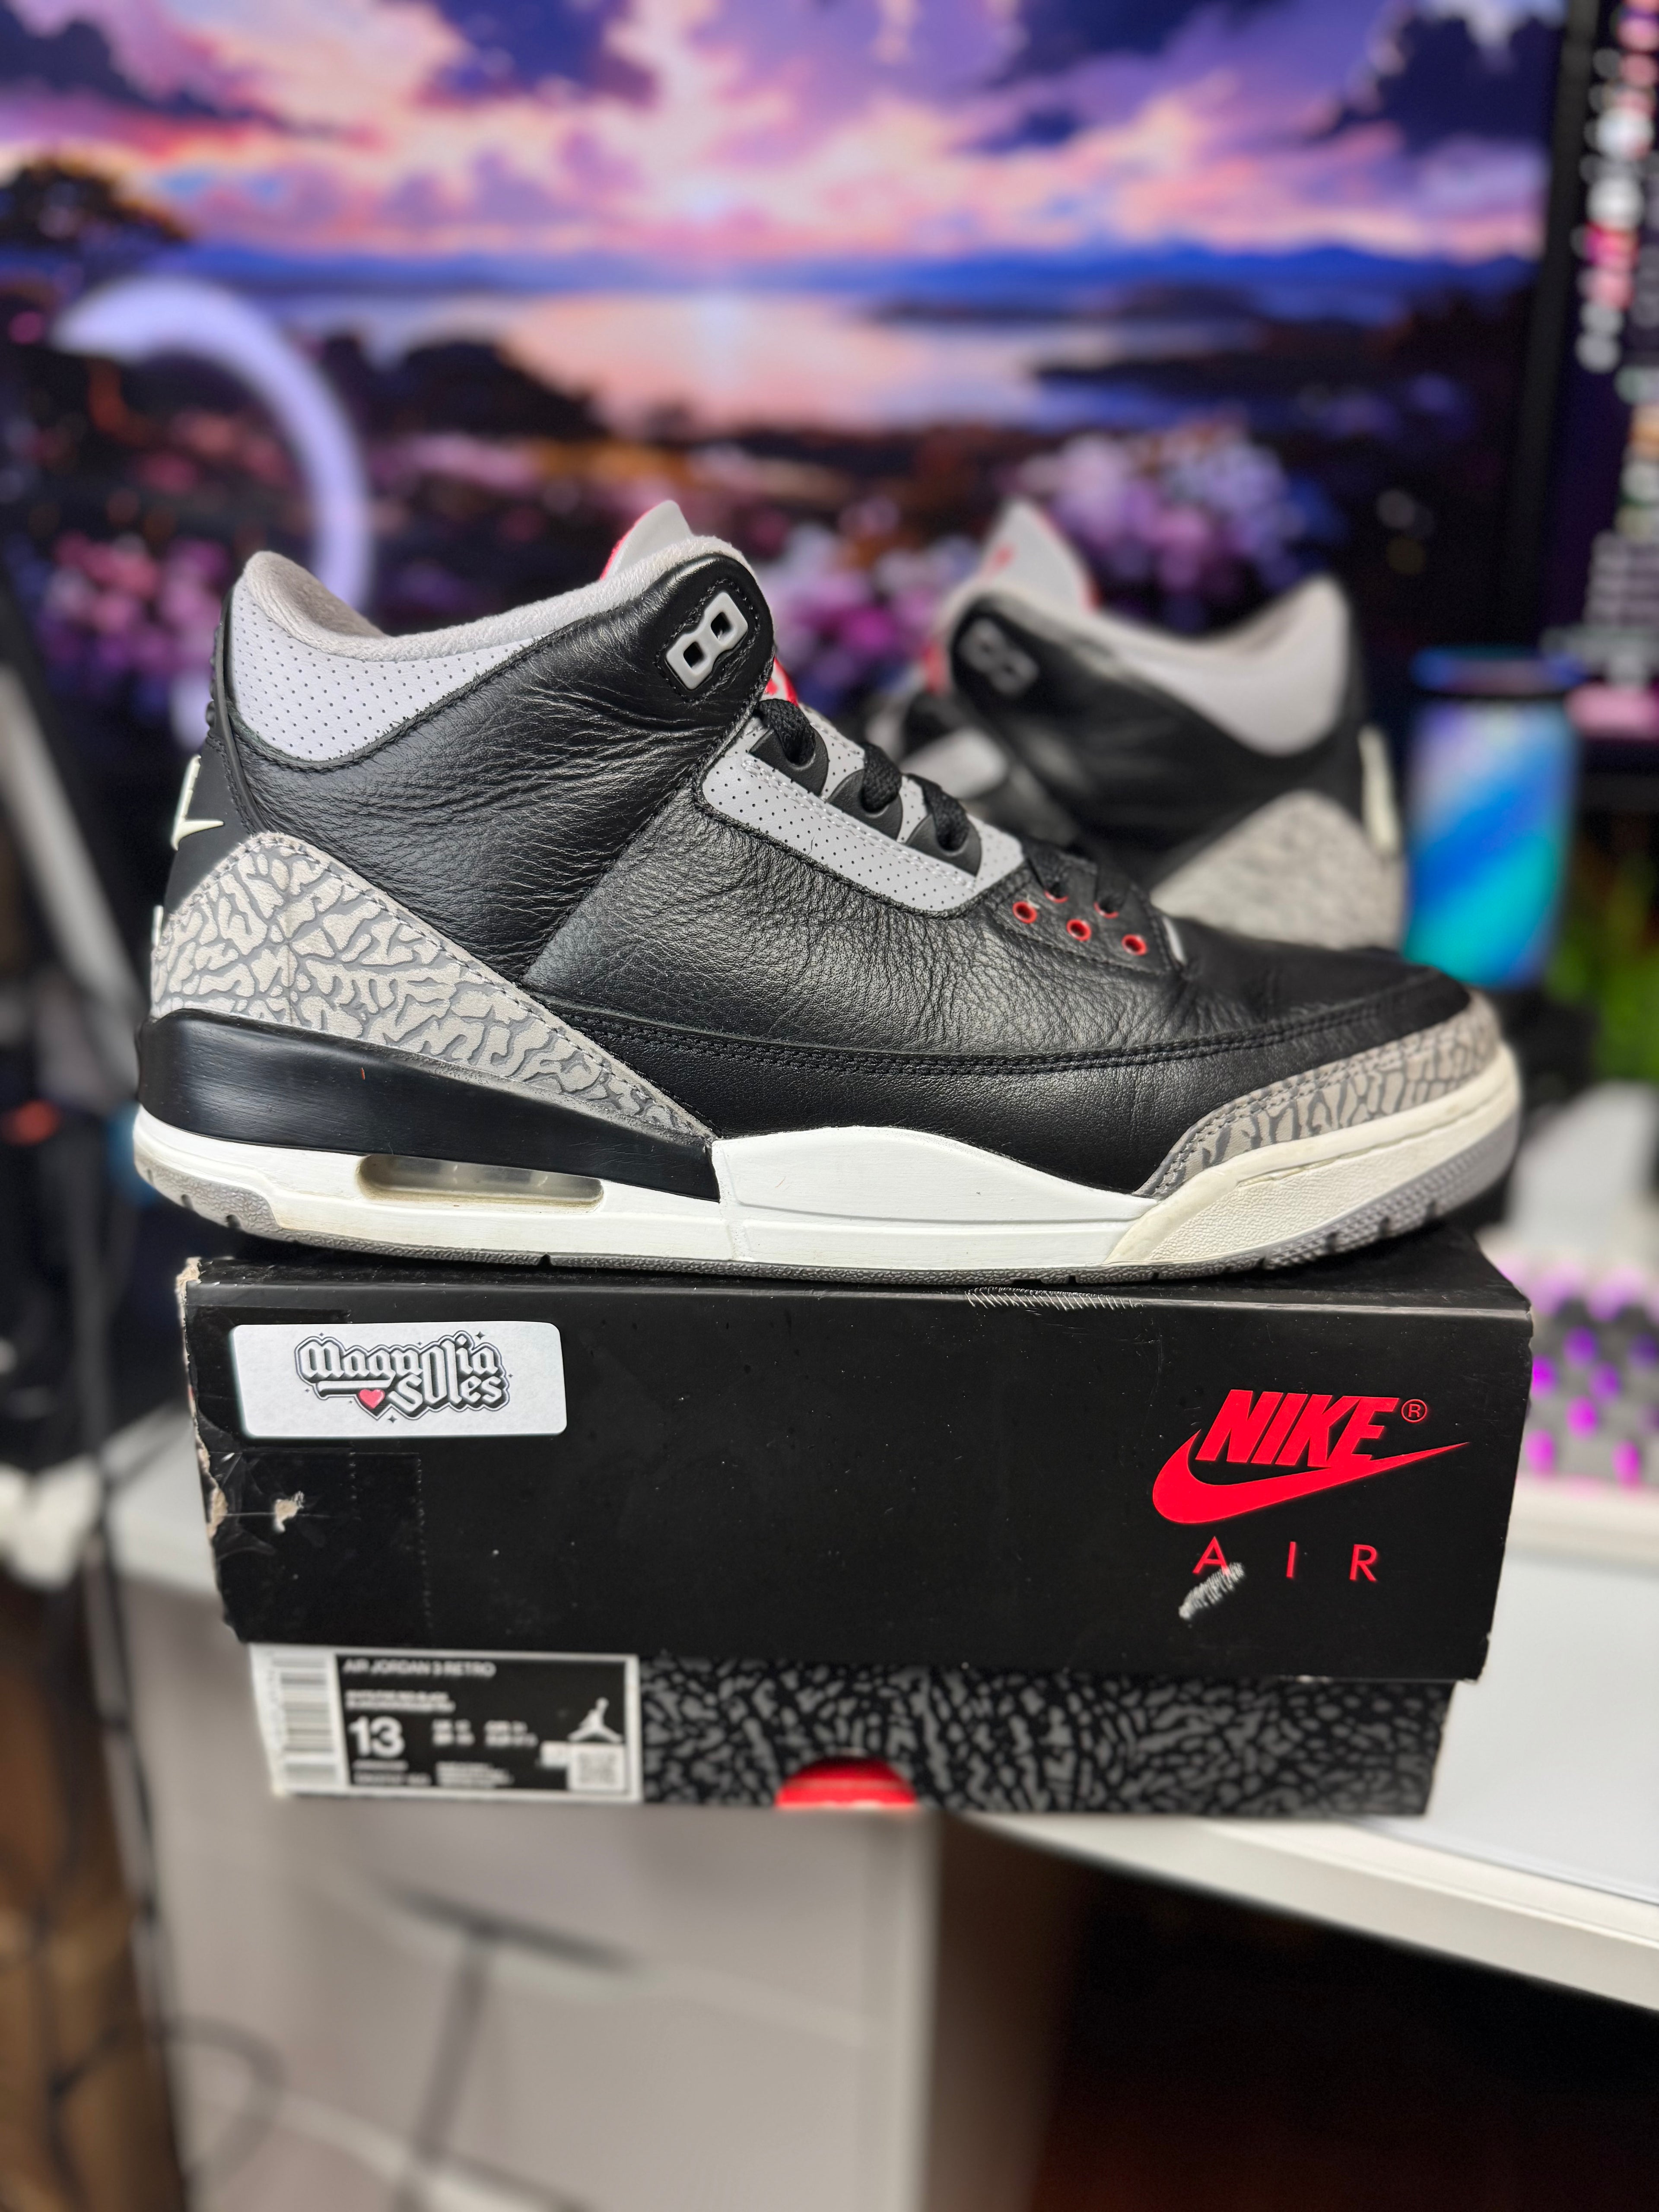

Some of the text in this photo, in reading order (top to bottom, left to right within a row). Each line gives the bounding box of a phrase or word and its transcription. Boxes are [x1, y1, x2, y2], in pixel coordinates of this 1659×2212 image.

[1195, 1389, 1400, 1468] NIKE
[1192, 1535, 1377, 1582] AIR
[343, 1658, 369, 1674] AIR
[370, 1659, 432, 1676] JORDAN
[443, 1660, 496, 1678] RETRO
[348, 1716, 405, 1758] 13
